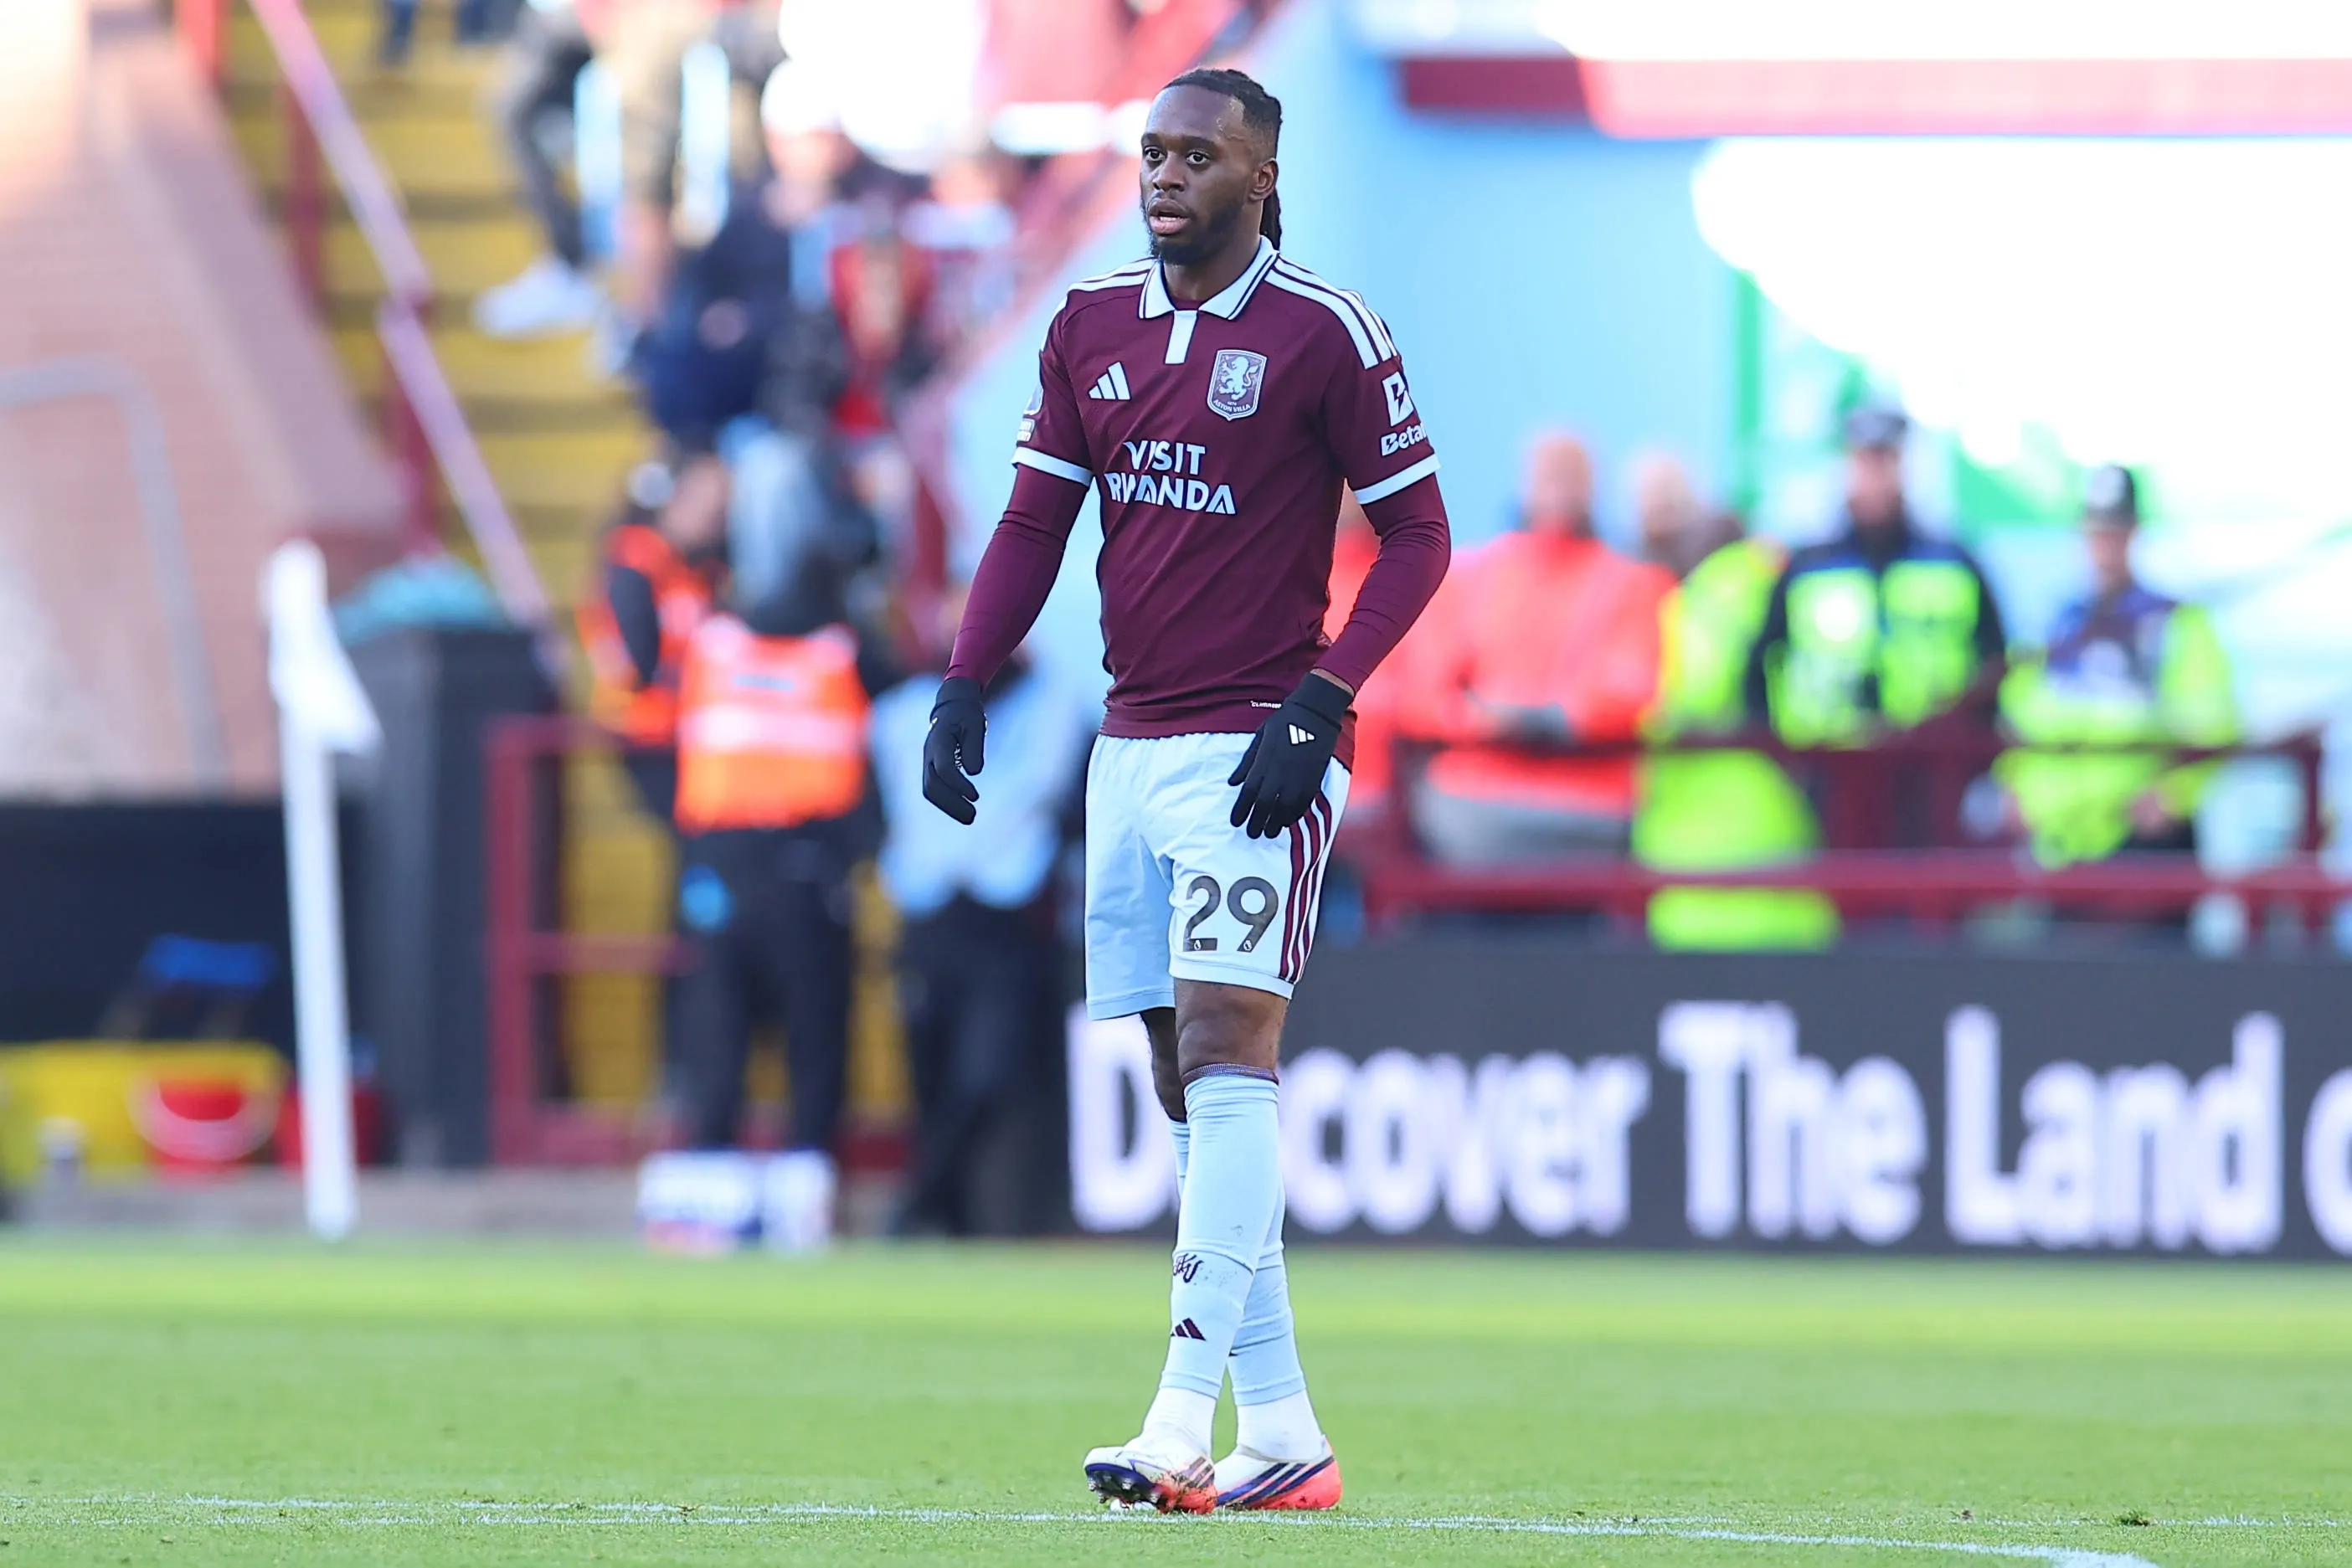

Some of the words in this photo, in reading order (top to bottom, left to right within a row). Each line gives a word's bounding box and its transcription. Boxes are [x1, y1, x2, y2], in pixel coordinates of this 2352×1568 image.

[1214, 400, 1233, 412] ASTON
[1123, 440, 1206, 476] VISIT
[1104, 472, 1237, 515] RWANDA
[1182, 875, 1279, 953] 29
[1066, 1000, 1651, 1236] Dcover
[1657, 1000, 1927, 1245] The
[1944, 1003, 2285, 1255] Land
